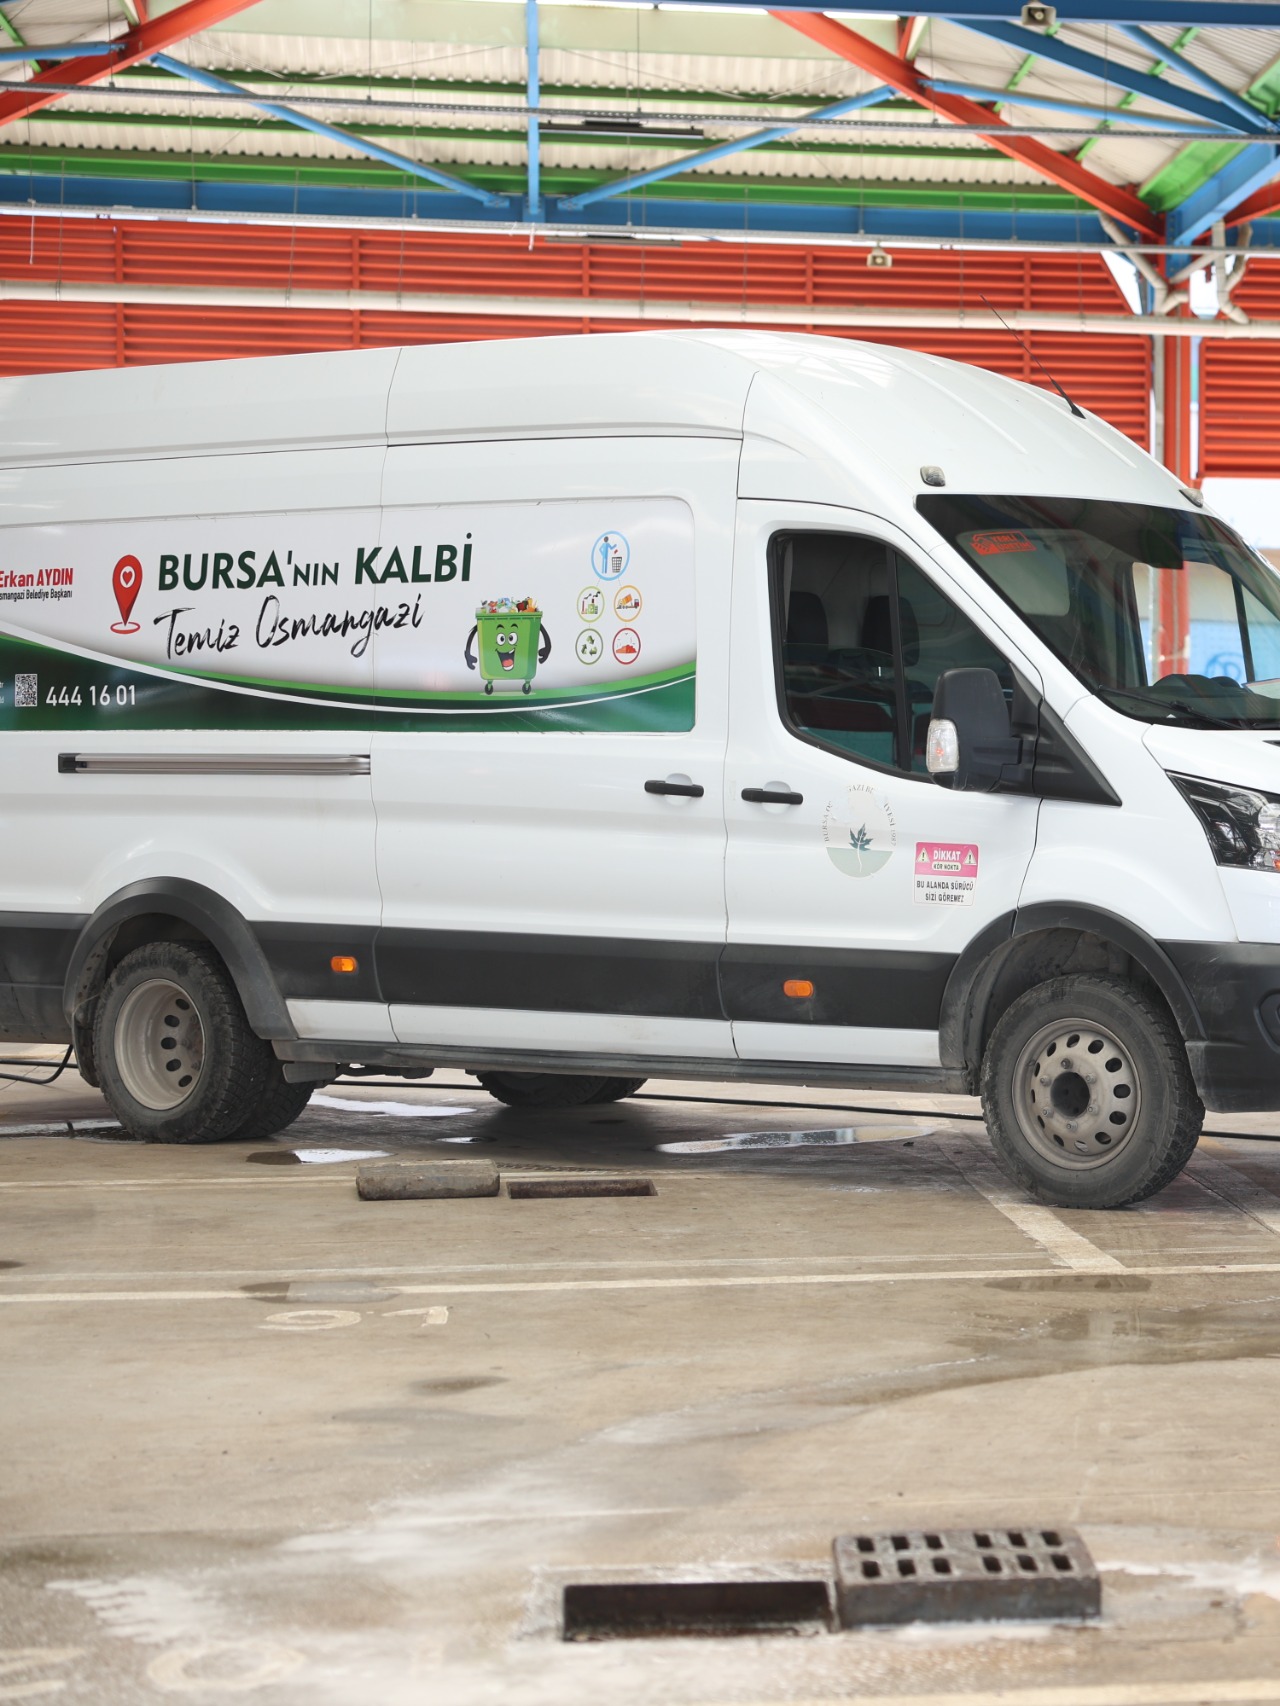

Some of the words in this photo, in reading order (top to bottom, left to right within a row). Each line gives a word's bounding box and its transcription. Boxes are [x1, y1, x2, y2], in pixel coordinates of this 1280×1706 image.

[354, 532, 473, 585] KALBİ
[36, 568, 73, 587] AYDIN
[26, 589, 49, 601] Belediye
[50, 587, 73, 602] Başkanı
[153, 606, 241, 660] Temiz
[255, 593, 426, 658] Osmangazi
[45, 685, 82, 707] 444
[89, 684, 111, 706] 16
[116, 684, 136, 706] 01
[933, 847, 961, 861] DİKKAT
[944, 863, 960, 871] NOKTA
[916, 880, 925, 889] BU
[926, 881, 950, 890] ALANDA
[950, 880, 974, 891] SÜRÜCÜ
[925, 891, 937, 901] SİZİ
[938, 891, 965, 903] GÖREMEZ
